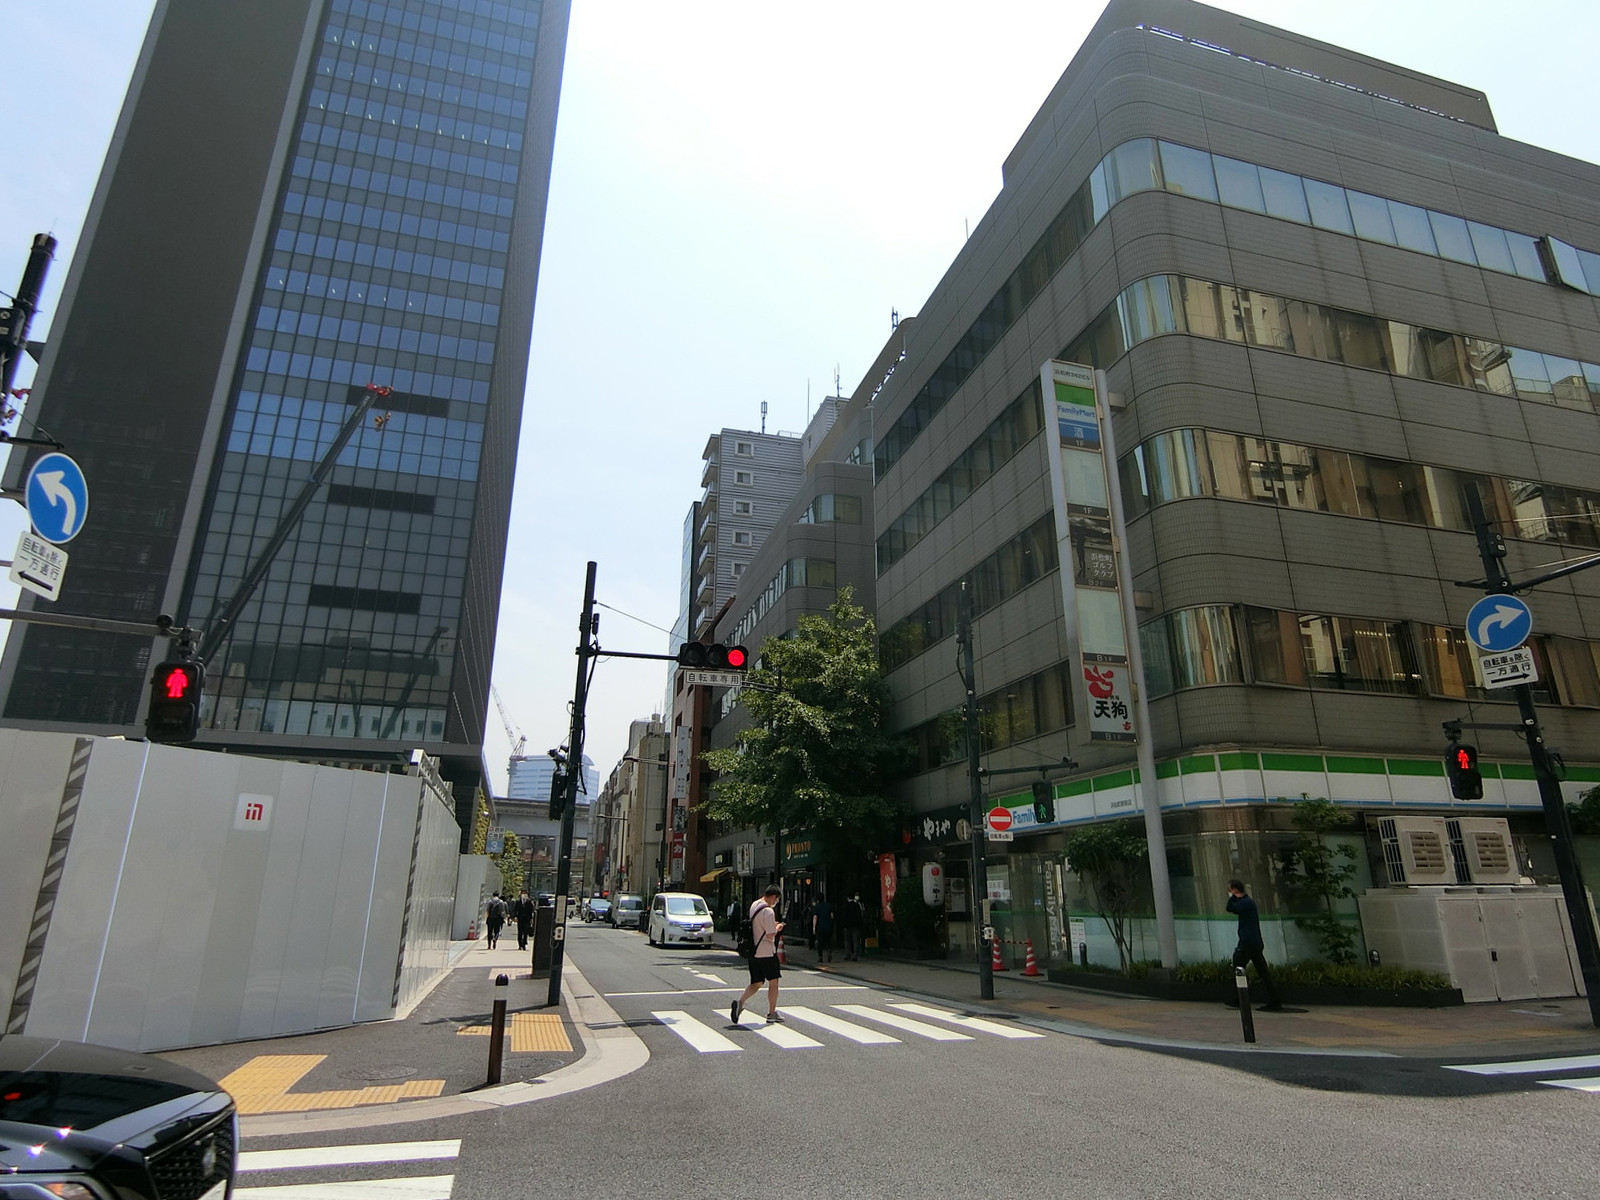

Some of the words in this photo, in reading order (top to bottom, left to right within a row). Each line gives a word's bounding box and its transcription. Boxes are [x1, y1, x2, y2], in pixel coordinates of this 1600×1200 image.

[1057, 405, 1095, 418] FamilyMart
[1083, 506, 1092, 514] 1F
[20, 555, 60, 581] 一方通行
[1092, 561, 1113, 570] ゴルフ
[1094, 569, 1114, 578] クラブ
[1088, 578, 1104, 586] B2F
[1096, 654, 1113, 662] B1F
[1483, 653, 1529, 668] 自転車を除く
[1486, 662, 1531, 676] 一方通行
[688, 672, 739, 685] 自転車専用
[1094, 700, 1128, 720] 天狗
[923, 816, 951, 841] やまや
[1044, 860, 1060, 957] FamilyMart
